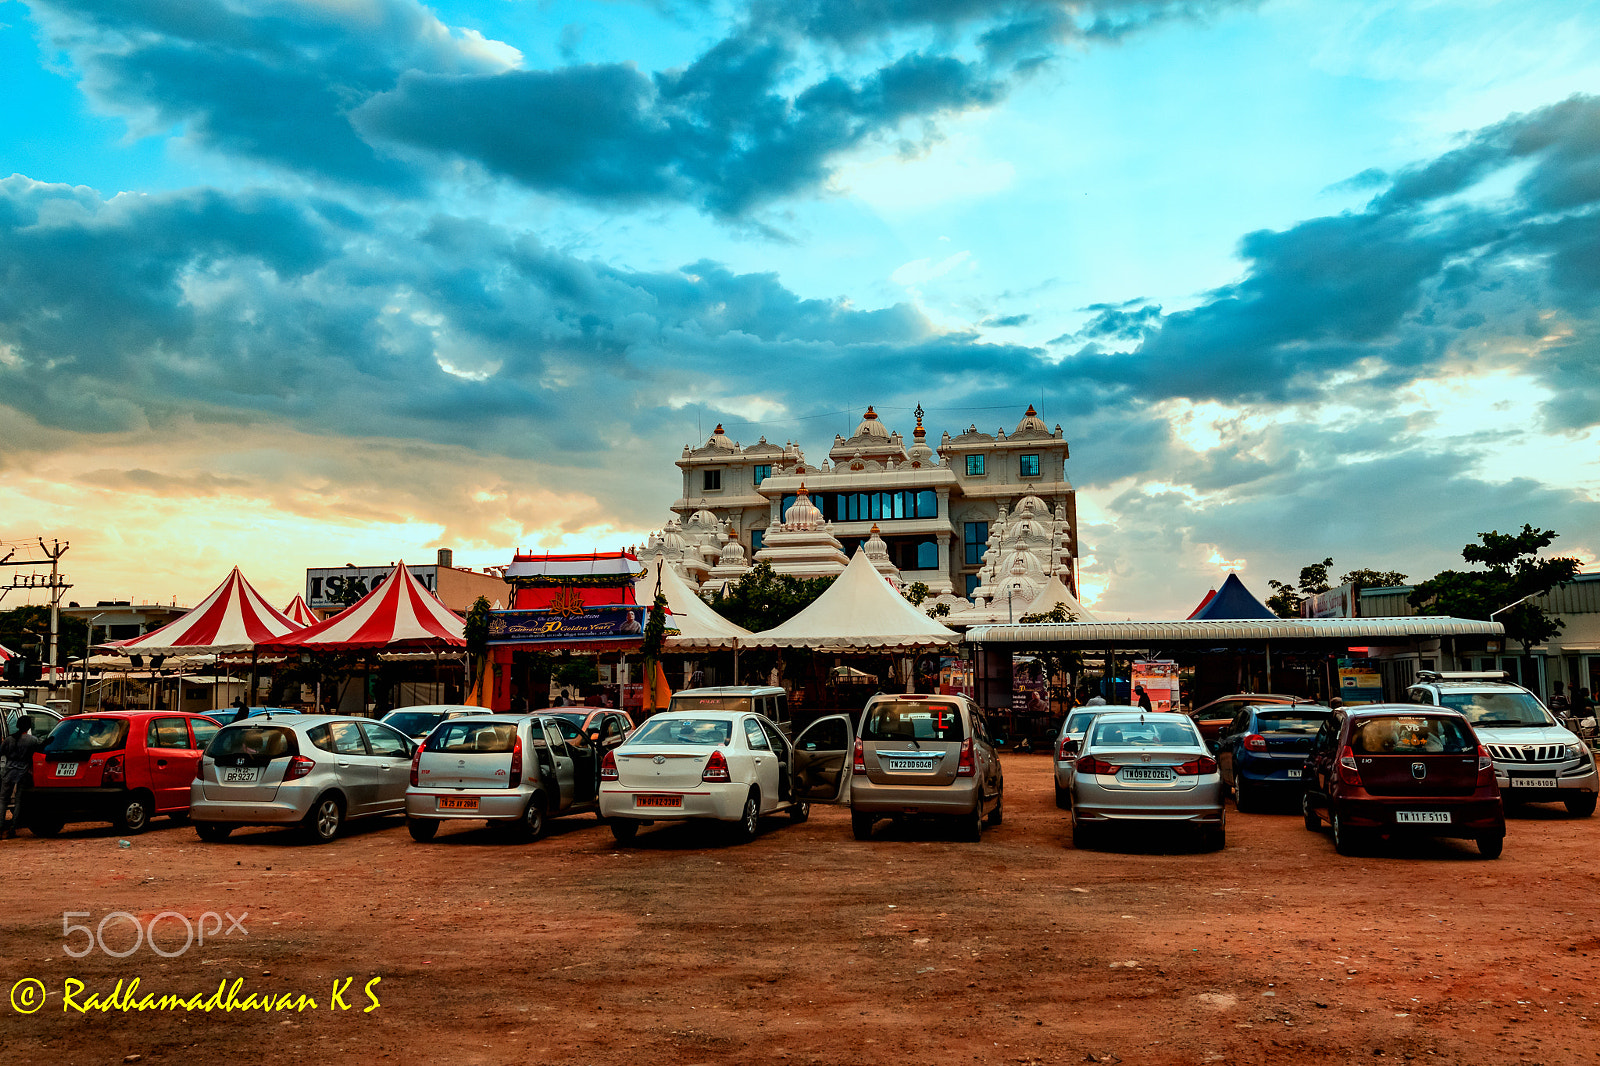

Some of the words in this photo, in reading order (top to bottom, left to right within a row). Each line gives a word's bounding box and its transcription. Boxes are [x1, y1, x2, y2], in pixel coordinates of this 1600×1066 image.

[543, 621, 562, 632] 50
[561, 624, 588, 632] Golden
[590, 621, 615, 631] Years
[938, 711, 949, 729] L
[1400, 812, 1409, 821] TN
[1411, 813, 1419, 821] 11
[1422, 813, 1426, 821] F
[1429, 813, 1448, 821] 5119
